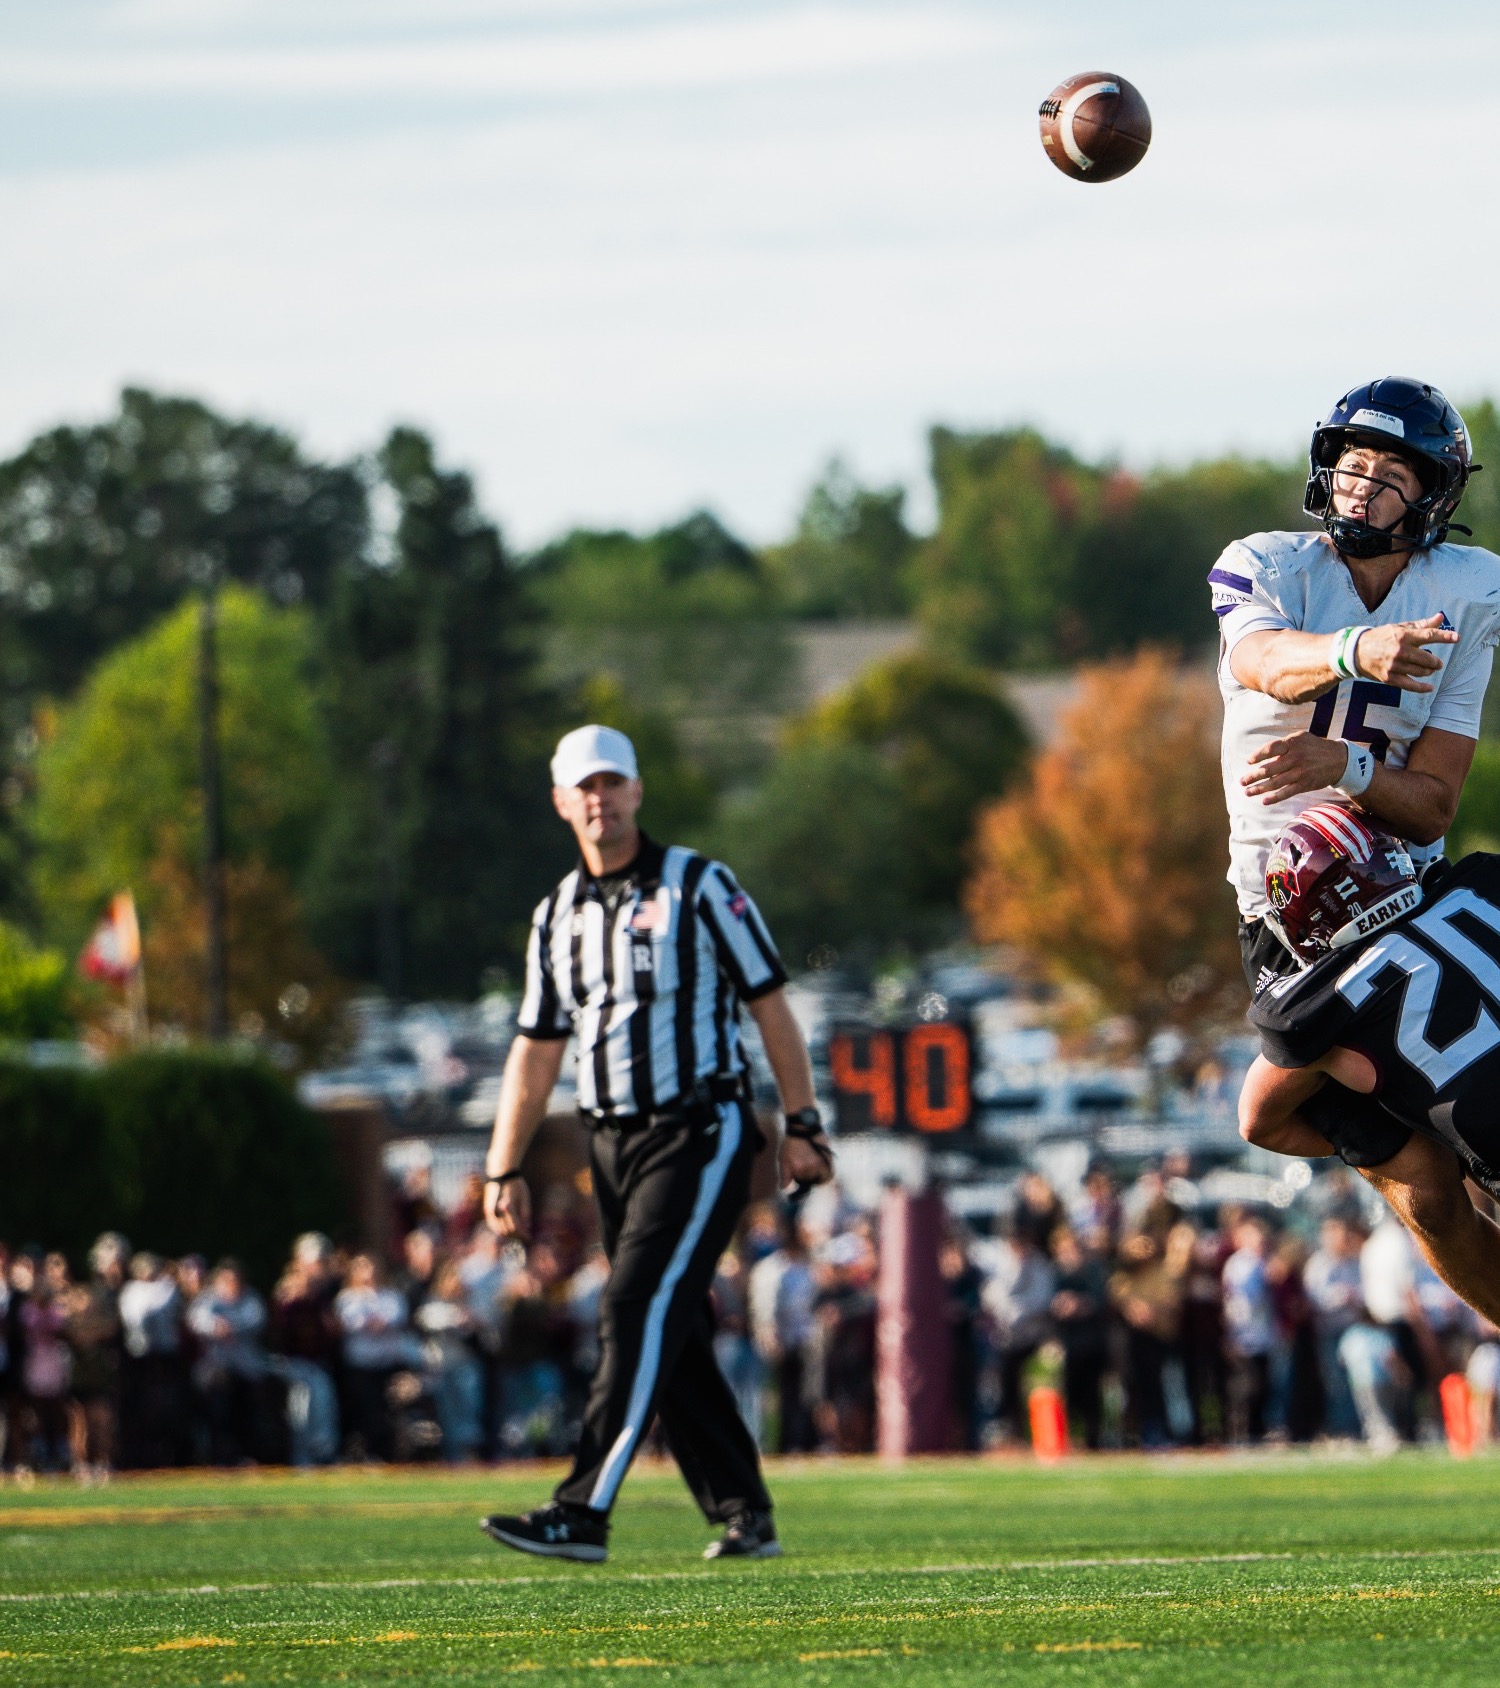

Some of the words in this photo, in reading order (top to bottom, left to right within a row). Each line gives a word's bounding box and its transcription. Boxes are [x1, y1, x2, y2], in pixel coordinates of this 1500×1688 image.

[1302, 681, 1401, 765] 15
[1347, 901, 1363, 918] 20
[1355, 898, 1403, 936] EARN
[1401, 890, 1416, 910] IT
[633, 944, 652, 972] R
[1255, 971, 1279, 994] adidas
[830, 1022, 971, 1133] 40
